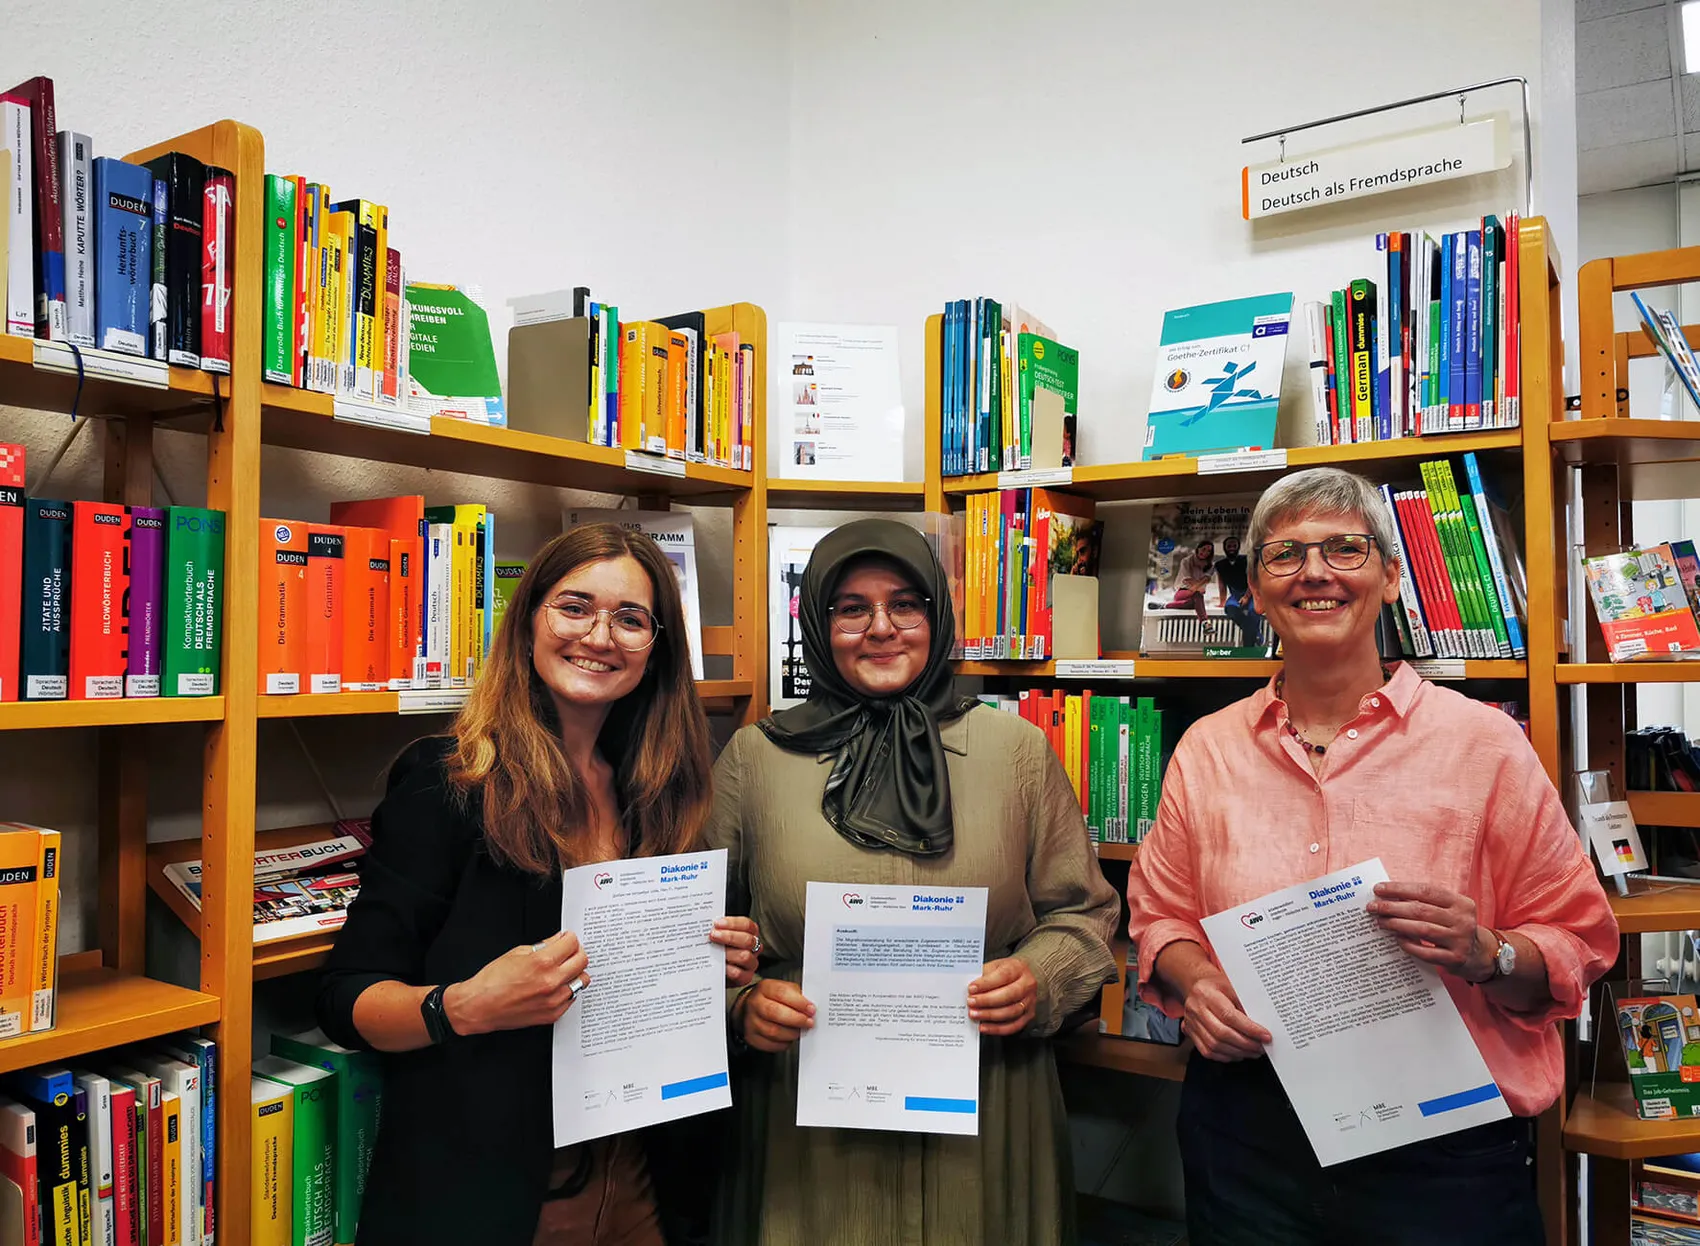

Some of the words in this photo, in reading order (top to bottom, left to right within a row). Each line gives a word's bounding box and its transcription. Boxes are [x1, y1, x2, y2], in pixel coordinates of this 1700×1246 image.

[1261, 161, 1319, 185] Deutsch
[1261, 187, 1321, 211] Deutsch
[1325, 181, 1345, 197] als
[1350, 157, 1463, 191] Fremdsprache
[76, 169, 85, 212] WÖRTER?
[109, 195, 148, 214] DUDEN
[77, 214, 85, 254] KAPUTTE
[117, 225, 127, 276] Herkunfts-
[129, 231, 137, 286] wörterbuch
[277, 232, 285, 263] Deutsch
[363, 245, 373, 299] DUMMIES
[276, 311, 284, 330] Buch
[411, 304, 465, 316] KUNGSVOLL
[1356, 312, 1365, 350] dummies
[276, 332, 284, 354] große
[365, 318, 373, 369] Rechtschreibung
[1167, 346, 1238, 362] Goethe-Zertifikat
[276, 355, 284, 369] Das
[1357, 353, 1369, 402] German
[40, 508, 67, 518] DUDEN
[95, 514, 121, 524] DUDEN
[1207, 506, 1237, 515] Leben
[1241, 506, 1250, 514] in
[136, 518, 162, 528] DUDEN
[176, 515, 222, 534] PONS
[314, 536, 342, 546] DUDEN
[277, 553, 304, 564] DUDEN
[370, 560, 388, 570] DUDEN
[298, 570, 304, 579] 4
[496, 567, 525, 577] DUDEN
[43, 577, 51, 599] UND
[53, 567, 62, 632] AUSSPRÜCHE
[103, 551, 112, 634] BILDWÖRTERBUCH
[195, 581, 205, 600] ALS
[324, 564, 333, 619] Grammatik
[1486, 582, 1498, 613] DEUTSCH
[42, 602, 51, 631] ZITATE
[183, 561, 193, 650] Kompaktwörterbuch
[206, 569, 215, 650] FREMDSPRACHE
[195, 602, 204, 649] DEUTSCH
[46, 852, 54, 877] DUDEN
[660, 863, 699, 875] Diakonie
[660, 874, 698, 884] Mark-Ruhr
[1308, 881, 1351, 900] Diakonie
[912, 895, 954, 904] Diakonie
[1313, 891, 1356, 909] Mark-Ruhr
[9, 904, 17, 948] Fremdsprache
[43, 900, 51, 932] Synonyme
[41, 945, 49, 982] Wörterbuch
[260, 1103, 283, 1115] DUDEN
[126, 1106, 134, 1138] MACHST!
[58, 1125, 70, 1179] dummies
[78, 1146, 88, 1185] dummies
[128, 1166, 135, 1177] DU
[315, 1162, 324, 1184] ALS
[128, 1178, 136, 1193] WAS
[62, 1185, 72, 1224] Linguistik
[80, 1193, 88, 1219] gendern
[81, 1220, 89, 1241] Richtig
[104, 1209, 112, 1231] Sprache
[128, 1209, 136, 1243] SPRACHE
